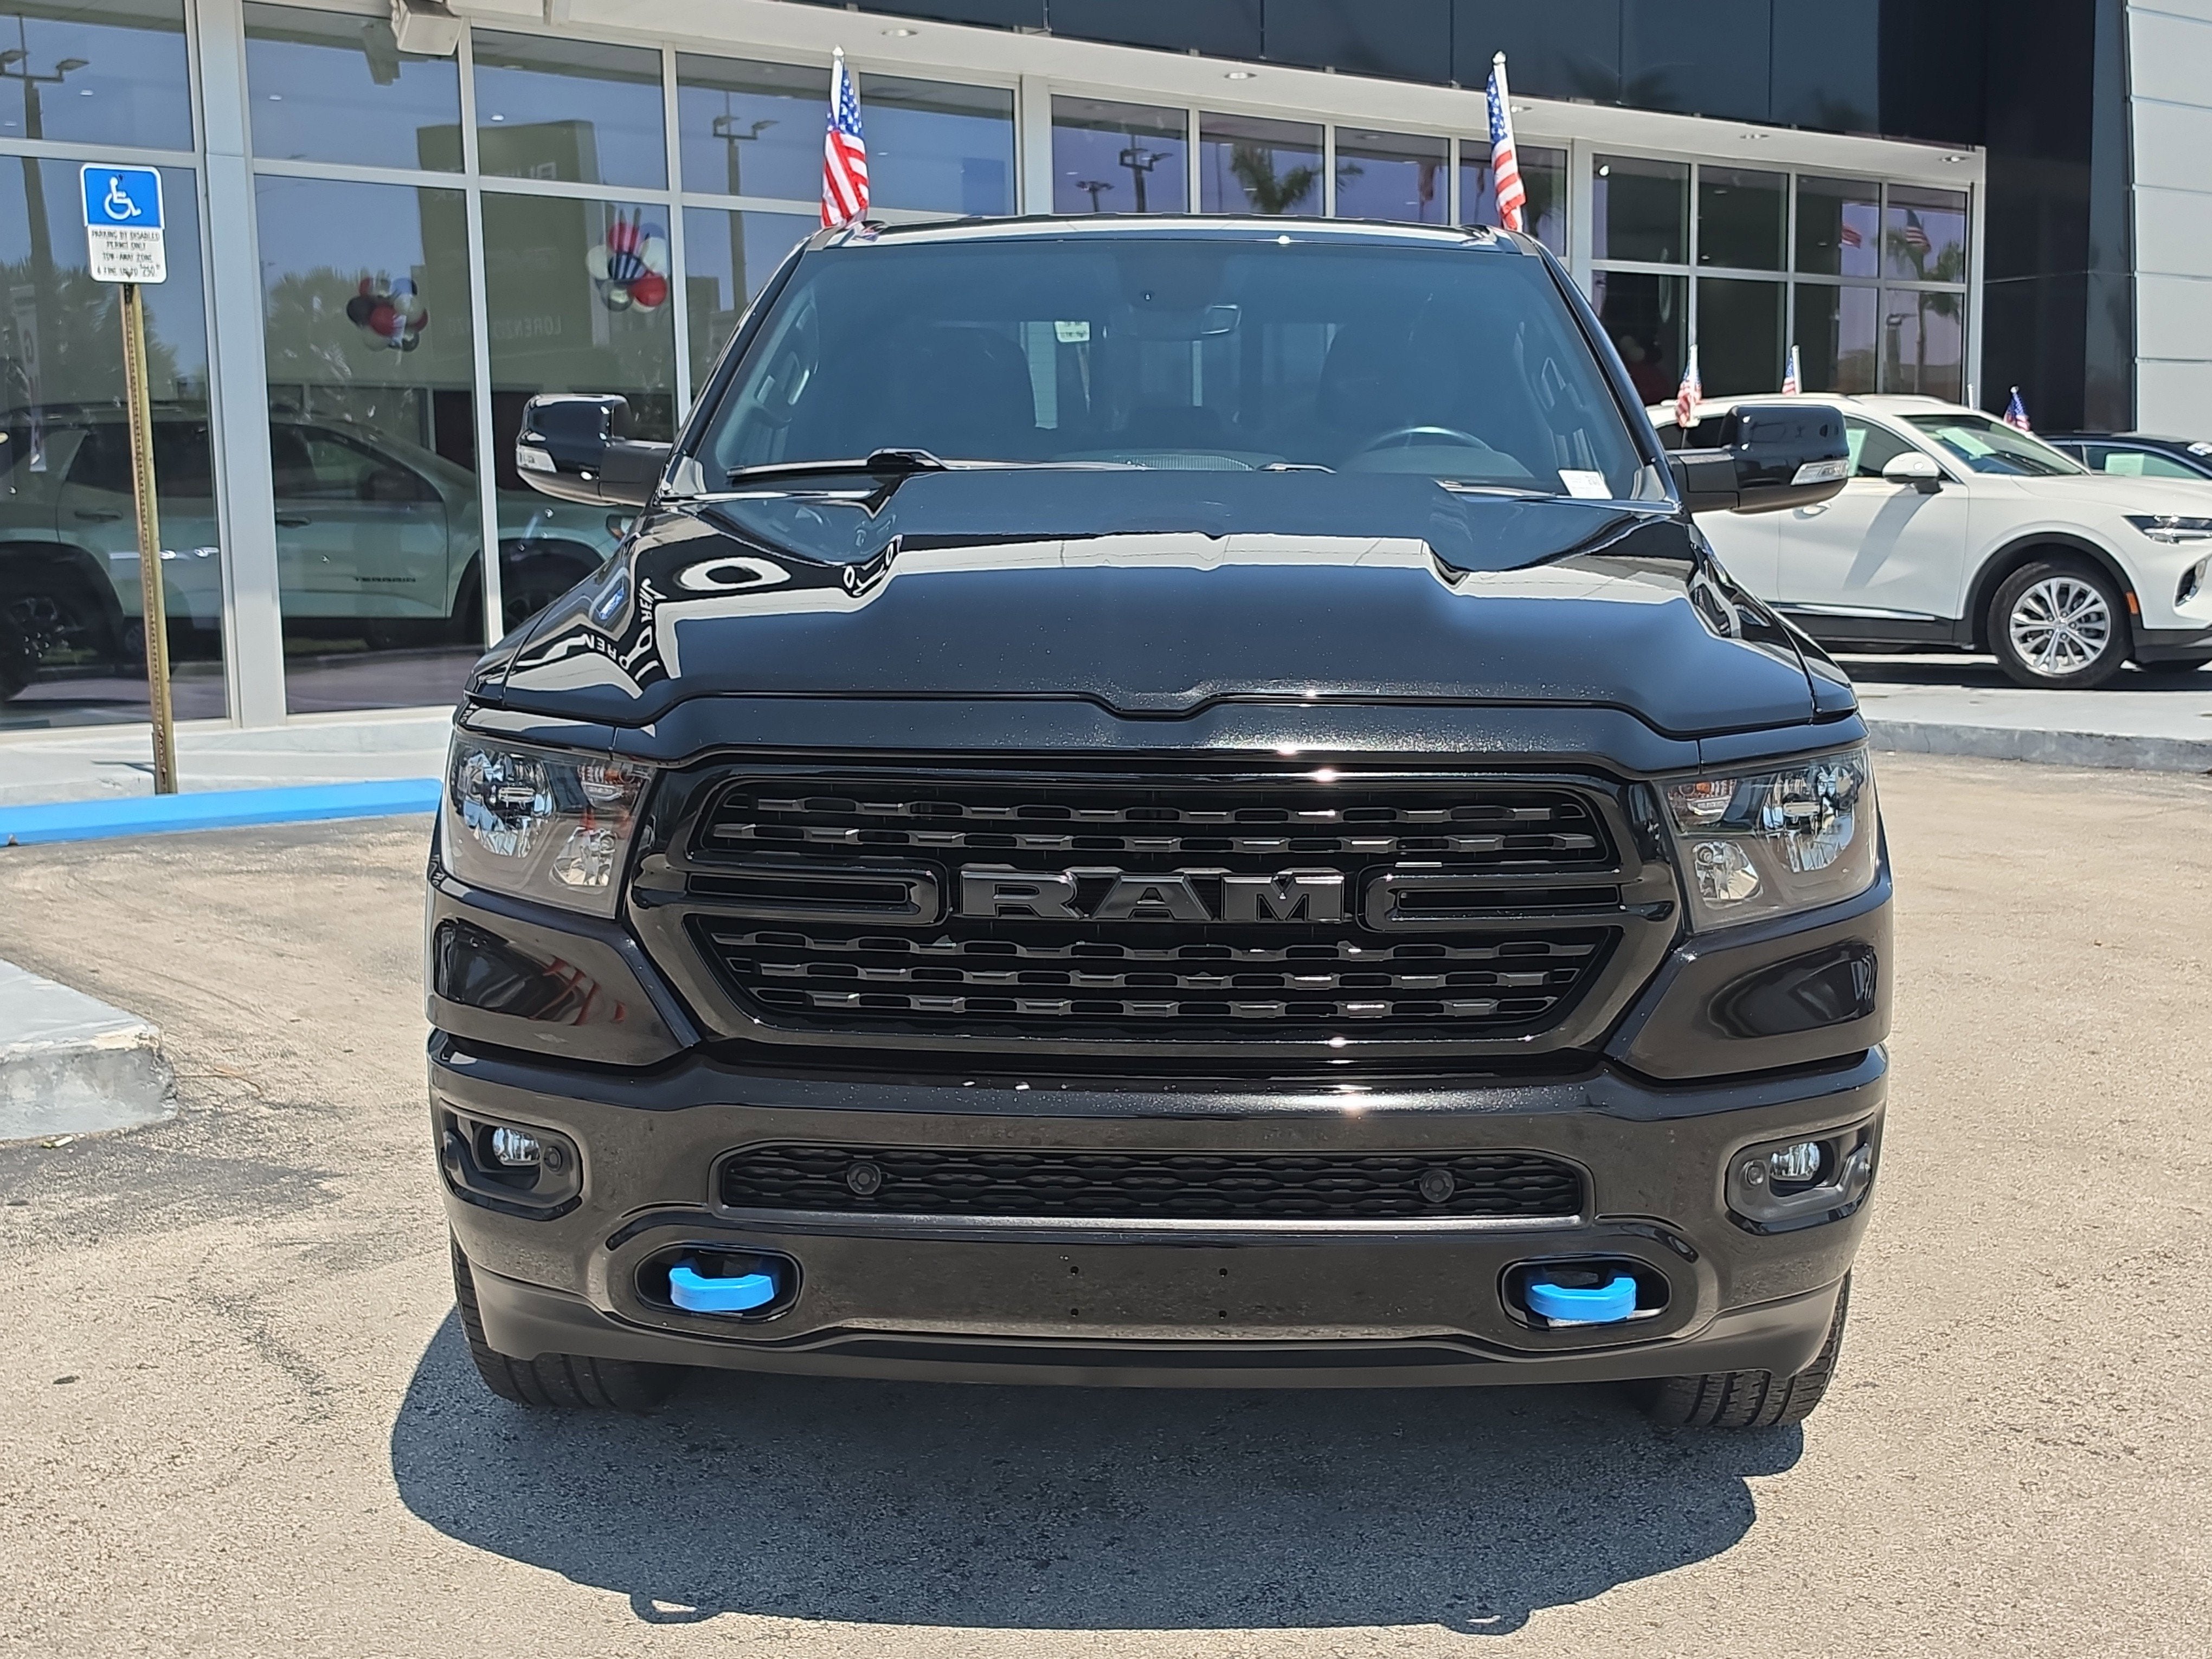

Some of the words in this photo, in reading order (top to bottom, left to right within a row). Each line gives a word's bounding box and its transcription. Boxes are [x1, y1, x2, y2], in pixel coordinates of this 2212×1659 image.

[92, 230, 118, 239] PARKING
[130, 232, 160, 241] DISABLED
[960, 869, 1347, 922] RAM
